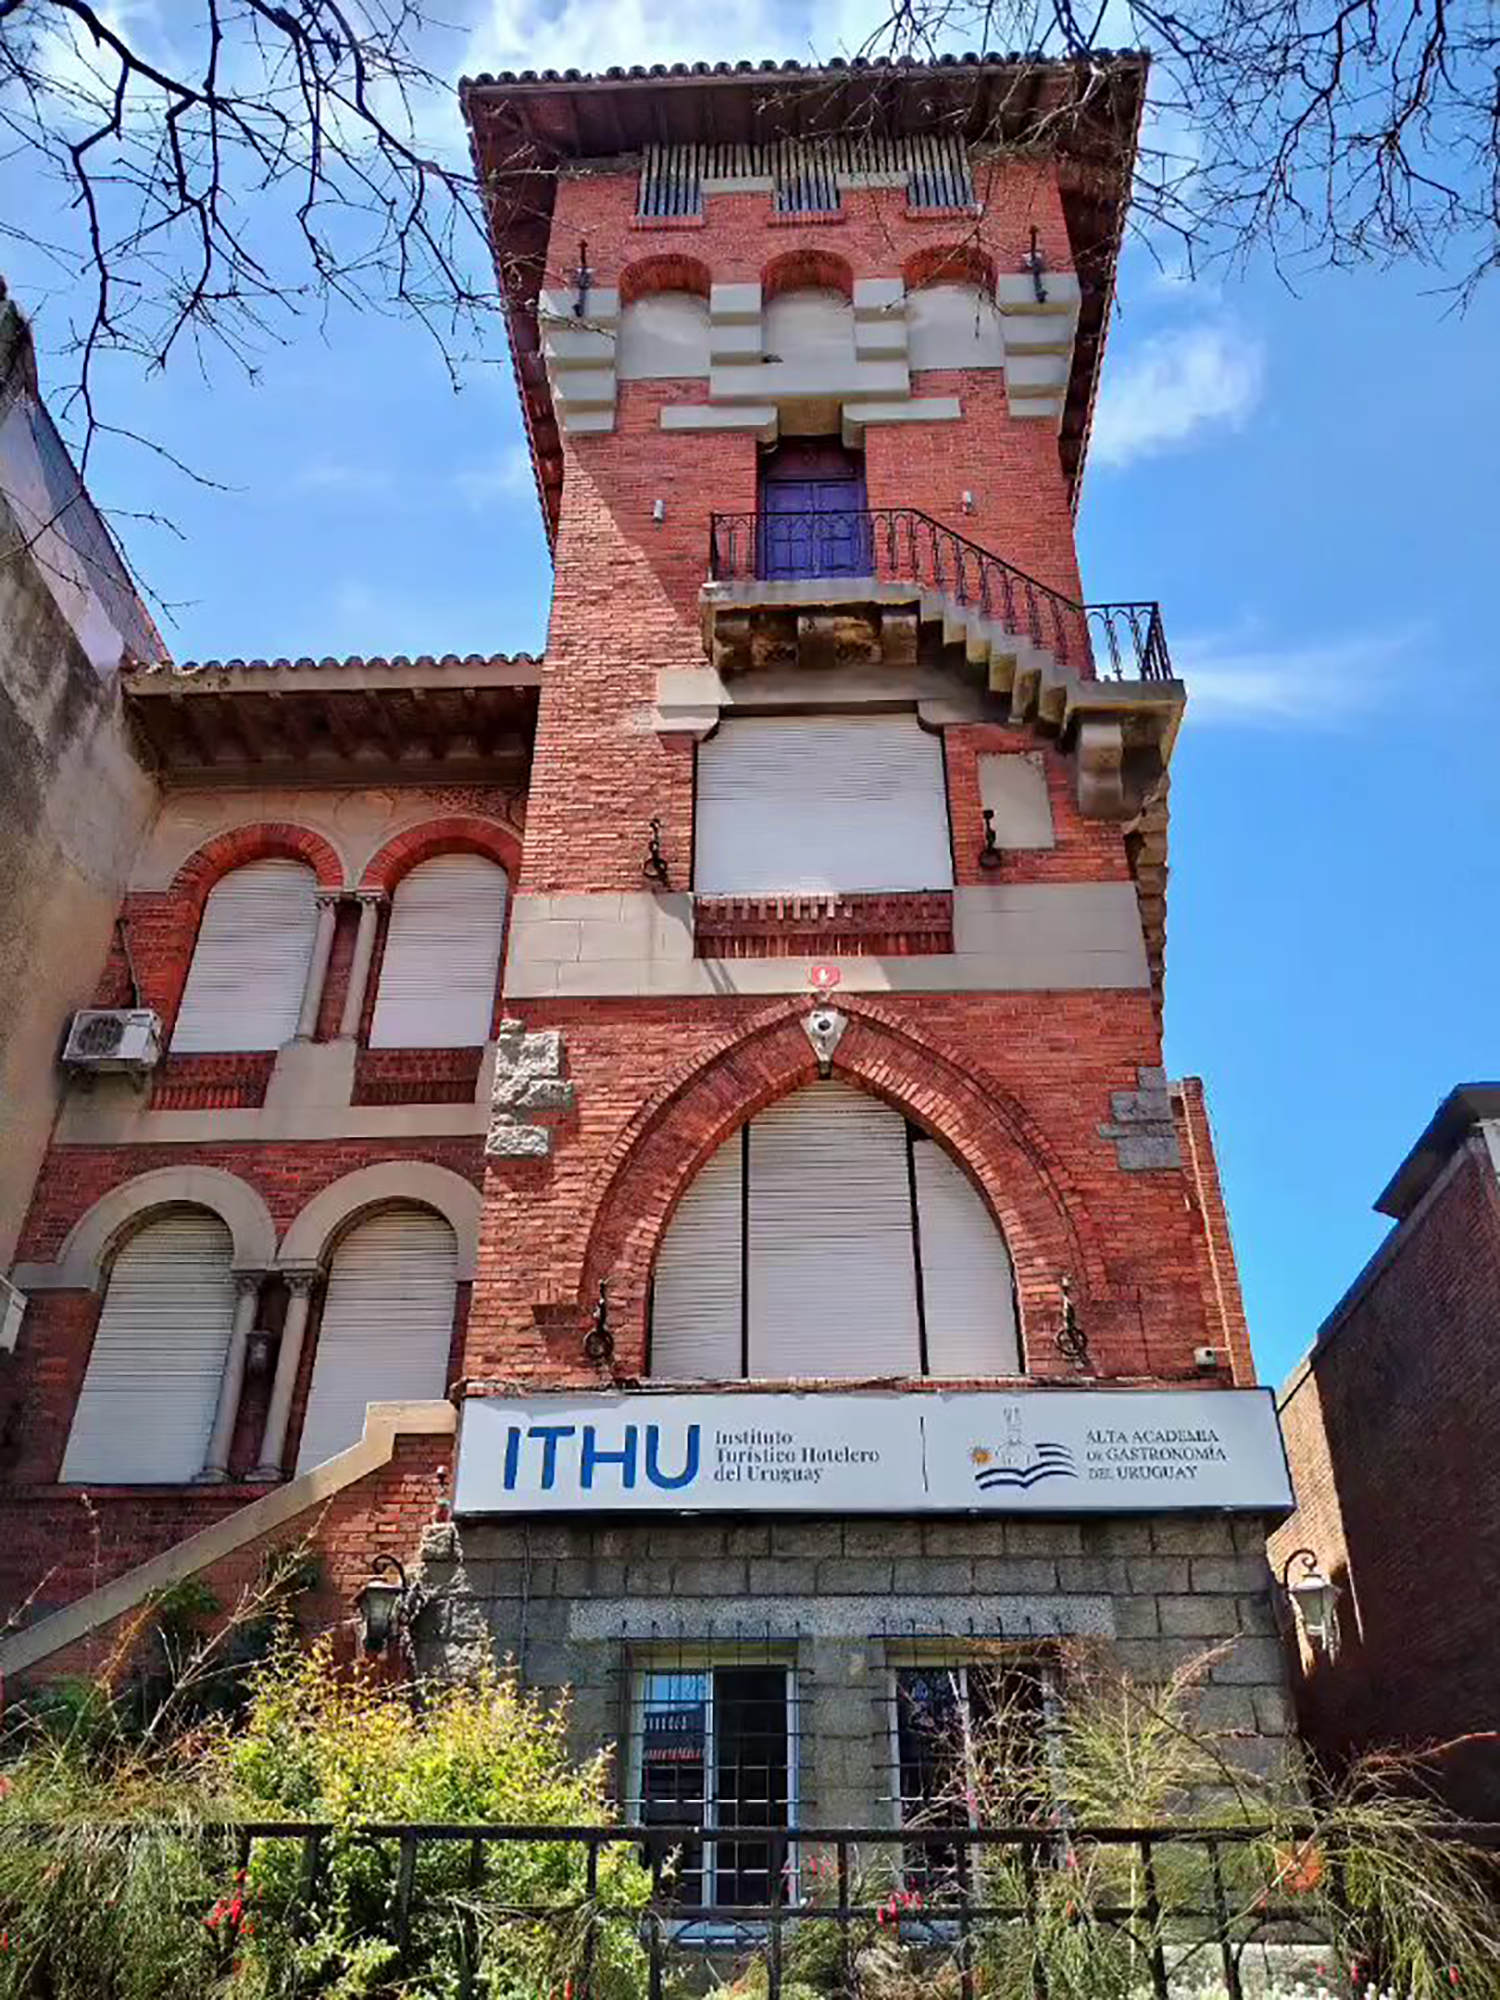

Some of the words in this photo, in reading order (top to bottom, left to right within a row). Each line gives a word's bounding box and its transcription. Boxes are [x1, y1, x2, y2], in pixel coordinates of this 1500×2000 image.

[715, 1429, 793, 1446] Instituto
[1086, 1428, 1127, 1444] ALTA
[1132, 1428, 1220, 1443] ACADEMIA
[503, 1424, 701, 1490] ITHU
[801, 1446, 881, 1463] Hotelero
[714, 1463, 743, 1482] del
[747, 1464, 824, 1484] Uruguay
[1089, 1467, 1114, 1480] DEL
[1117, 1465, 1198, 1480] URUGUAY
